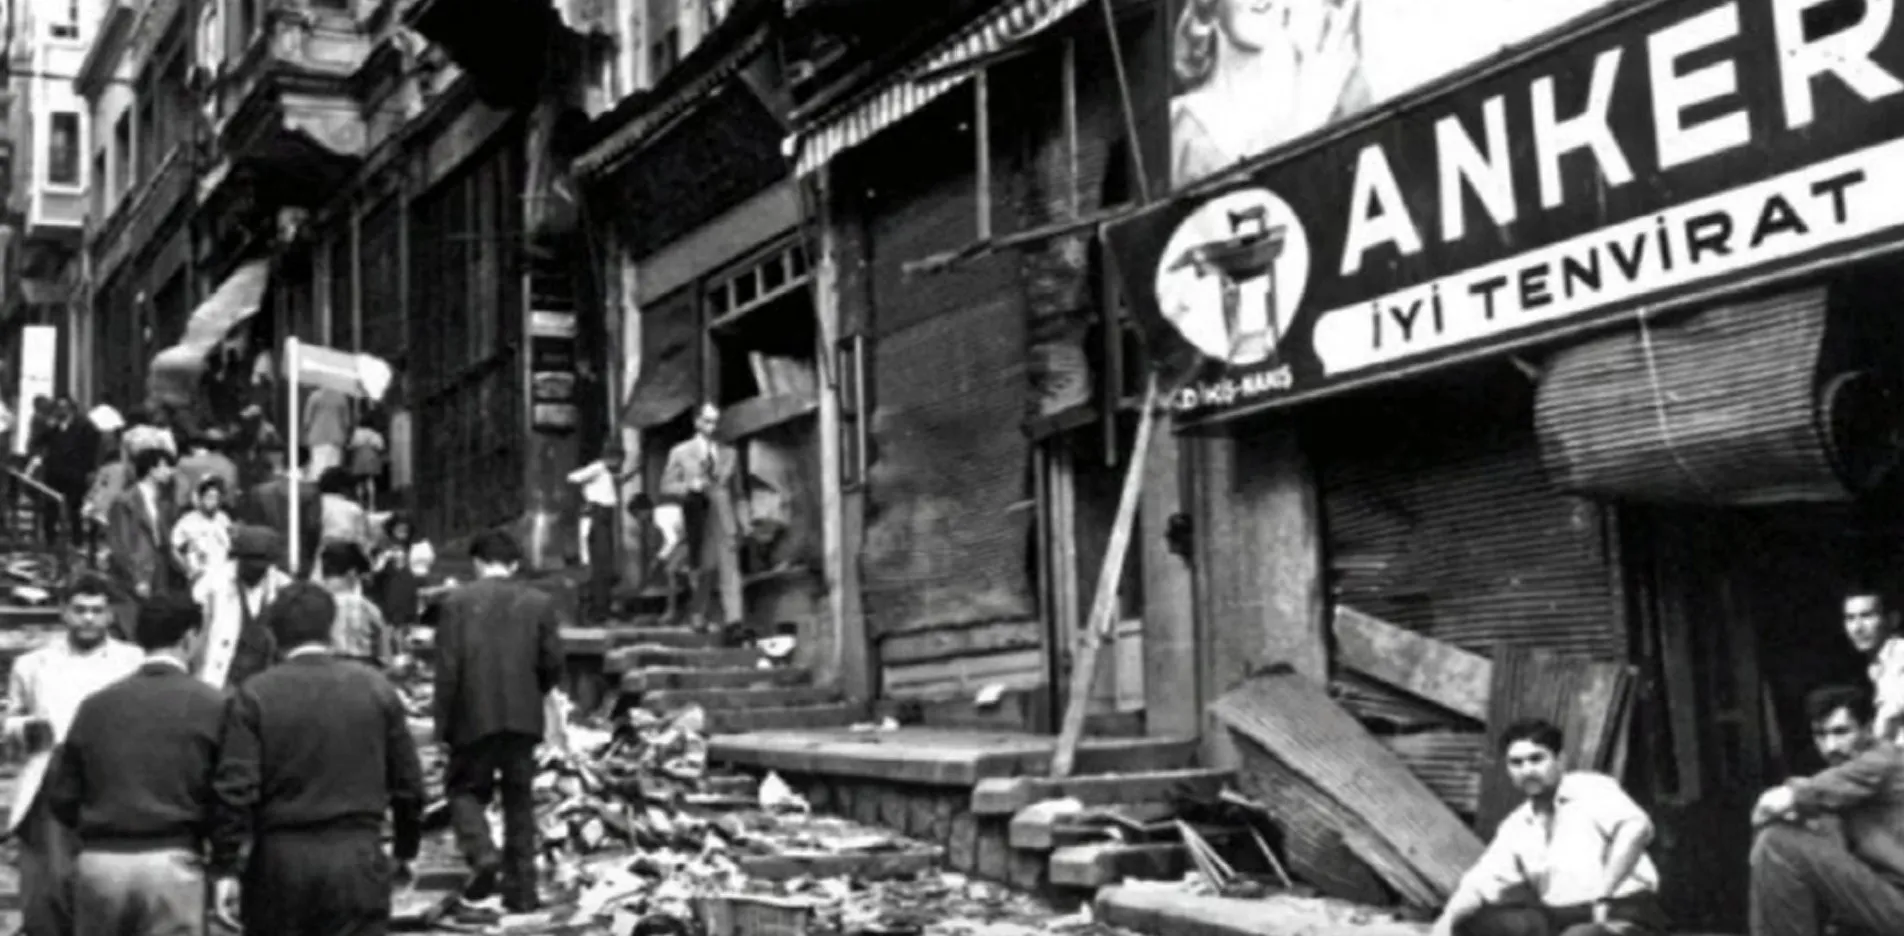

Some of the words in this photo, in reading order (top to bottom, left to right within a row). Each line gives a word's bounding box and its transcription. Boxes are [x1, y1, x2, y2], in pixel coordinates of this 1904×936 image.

[1340, 0, 1904, 276] ANKER
[1371, 283, 1443, 350] İYİ
[1468, 168, 1866, 320] TENVİRAT
